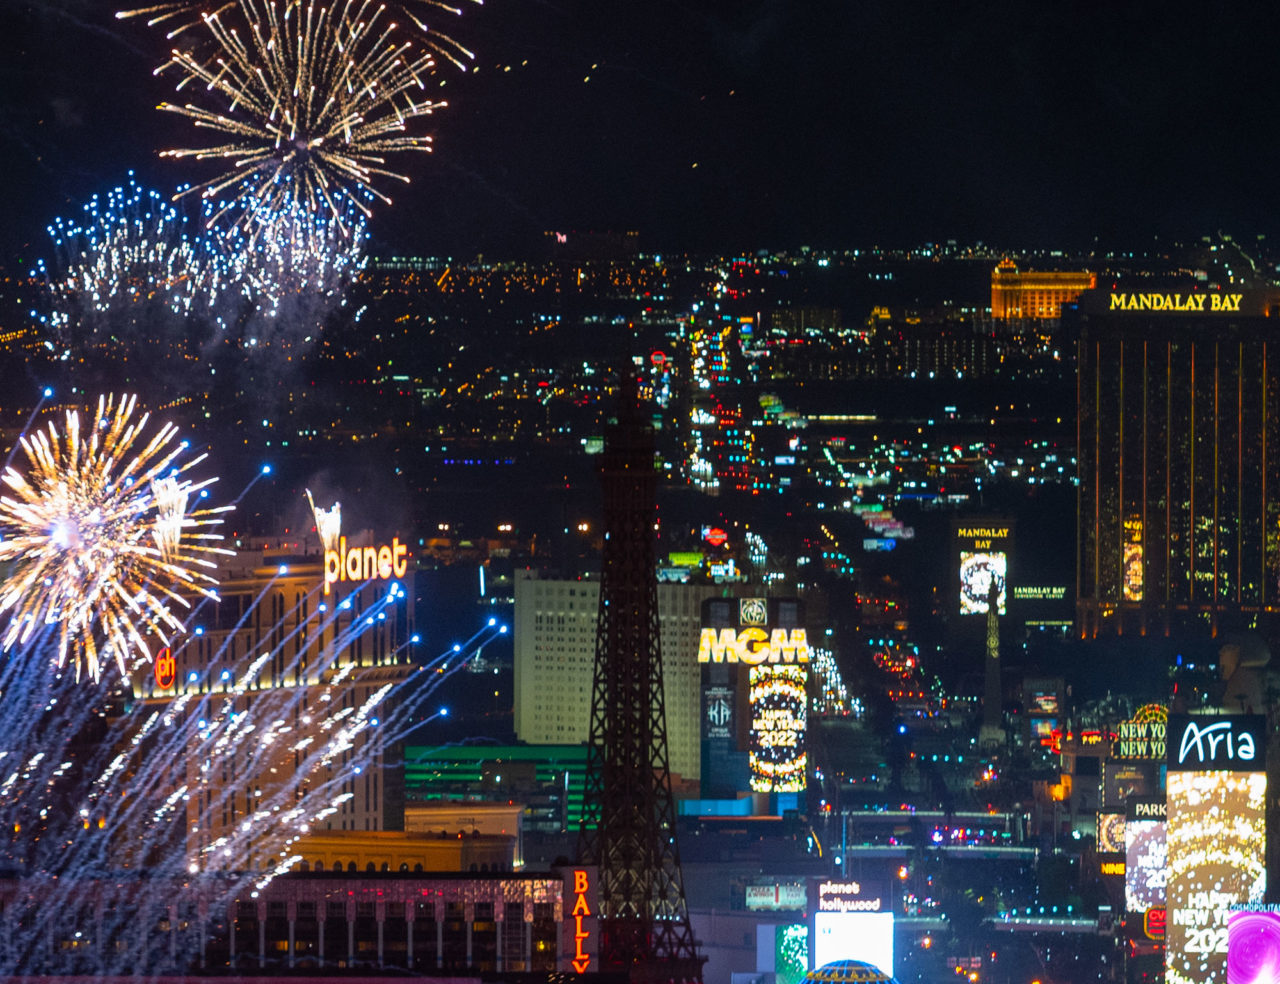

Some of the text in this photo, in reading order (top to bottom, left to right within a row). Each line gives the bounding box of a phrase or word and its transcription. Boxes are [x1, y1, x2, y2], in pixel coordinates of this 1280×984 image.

[1110, 293, 1243, 311] MANDALAY BAY
[958, 528, 1009, 537] MANDALAY
[975, 540, 992, 549] BAY
[324, 536, 408, 596] planet
[698, 627, 809, 665] MGM
[753, 719, 775, 730] NEW
[1120, 723, 1148, 739] NEW
[759, 730, 798, 746] 2022
[1179, 721, 1255, 764] Aria
[1120, 741, 1148, 756] NEW
[1101, 863, 1125, 874] NINE
[819, 880, 860, 895] planet
[819, 898, 880, 912] hollywood
[1188, 891, 1239, 909] HAPPY
[1173, 908, 1209, 926] NEW
